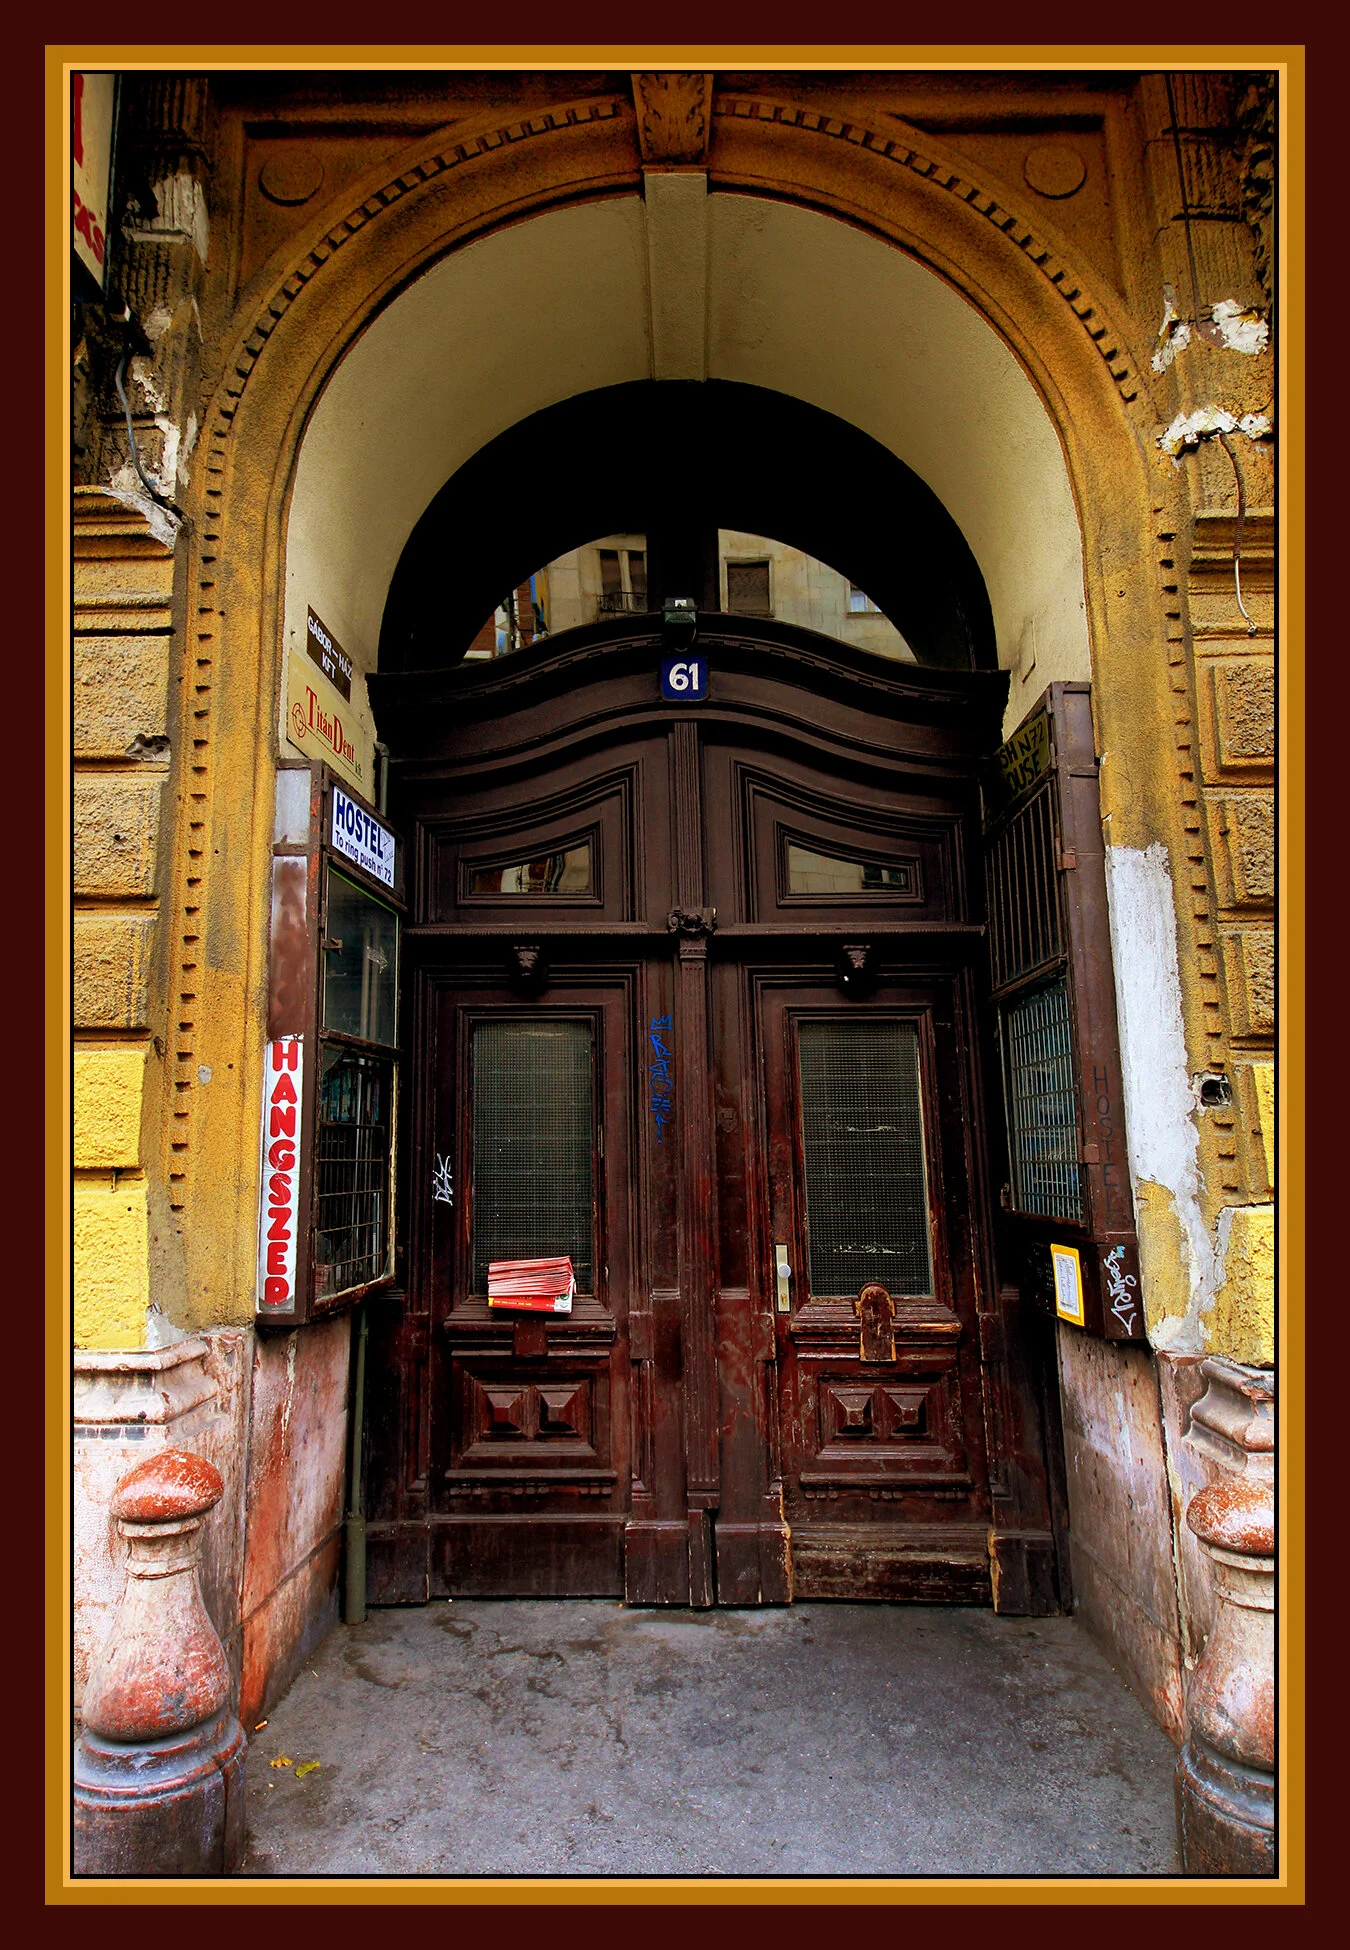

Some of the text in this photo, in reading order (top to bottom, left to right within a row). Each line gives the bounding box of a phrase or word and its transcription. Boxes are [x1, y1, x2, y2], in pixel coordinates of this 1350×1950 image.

[321, 652, 336, 679] KFT
[669, 662, 699, 691] 61
[335, 791, 384, 860] HOSTEL
[335, 829, 343, 848] To
[345, 839, 359, 863] ring
[359, 851, 376, 874] push
[384, 866, 392, 883] 72
[1093, 1065, 1121, 1213] HOSTEL
